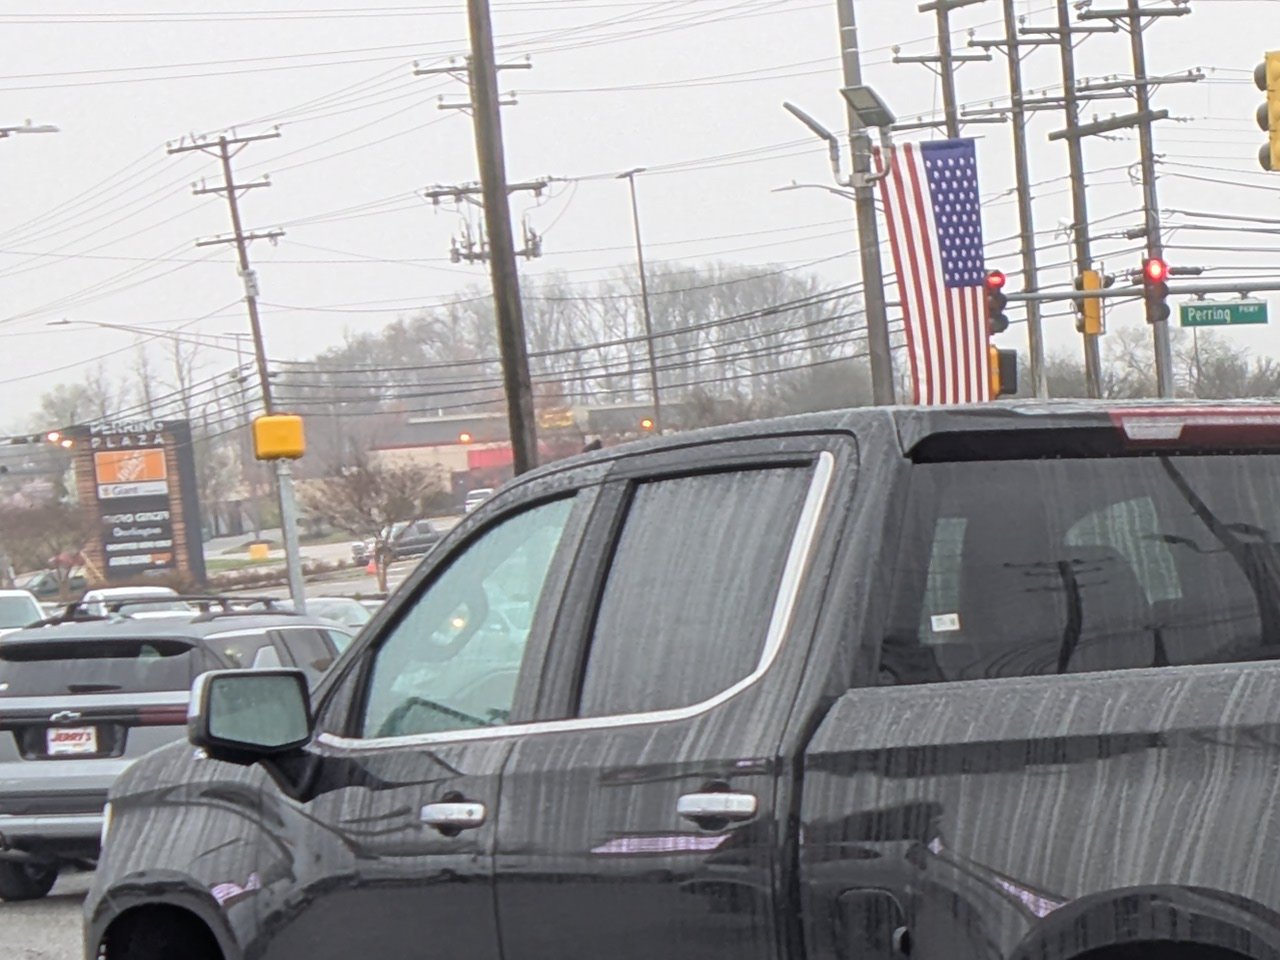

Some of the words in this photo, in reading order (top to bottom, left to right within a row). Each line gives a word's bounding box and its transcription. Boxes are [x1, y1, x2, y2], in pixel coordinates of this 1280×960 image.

[1188, 306, 1231, 323] Perring
[90, 420, 164, 435] PERRING
[90, 433, 165, 448] PLAZA
